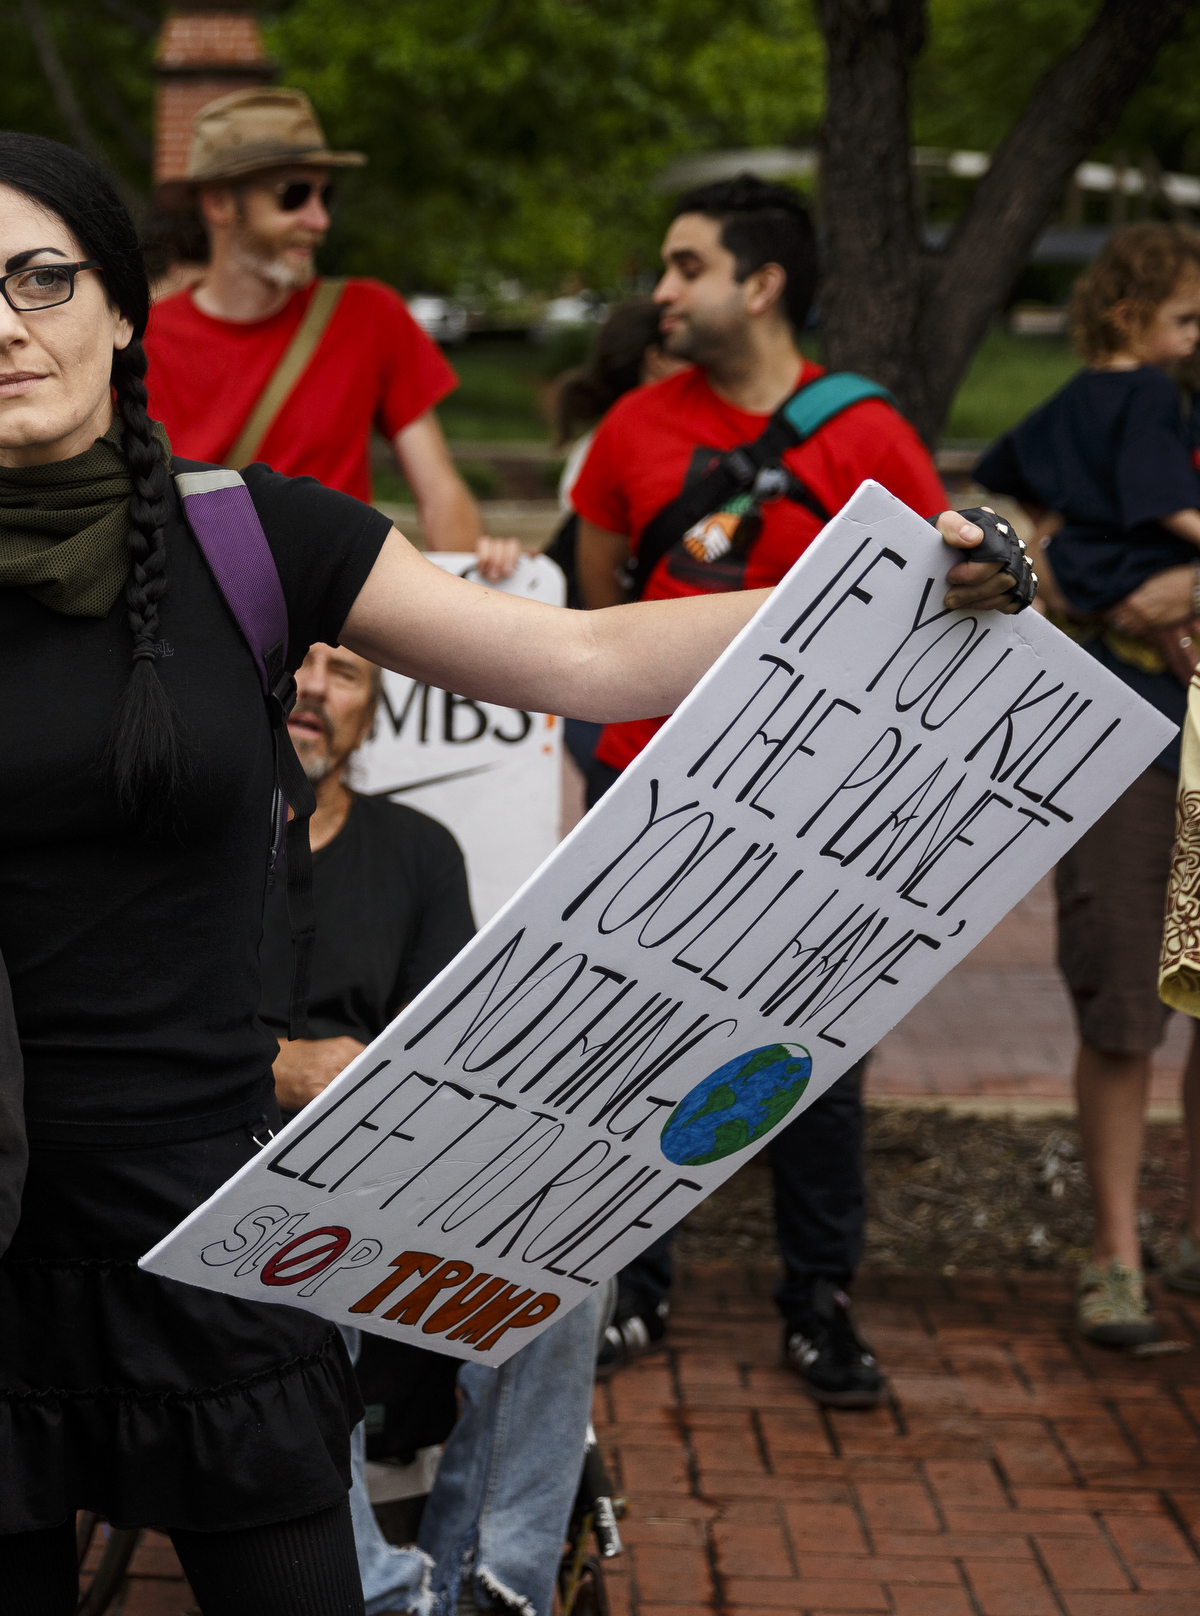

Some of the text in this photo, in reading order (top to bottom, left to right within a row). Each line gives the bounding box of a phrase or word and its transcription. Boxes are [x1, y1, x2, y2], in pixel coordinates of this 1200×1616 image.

[687, 653, 1051, 938] THE PLANET,
[780, 537, 1122, 822] IF YOU KILL
[404, 927, 738, 1141] NOTHING
[562, 779, 941, 1048] YOU'LL HAVE
[267, 1060, 516, 1210] LEFT
[418, 1104, 566, 1232] TO
[348, 1250, 561, 1352] TRUMP
